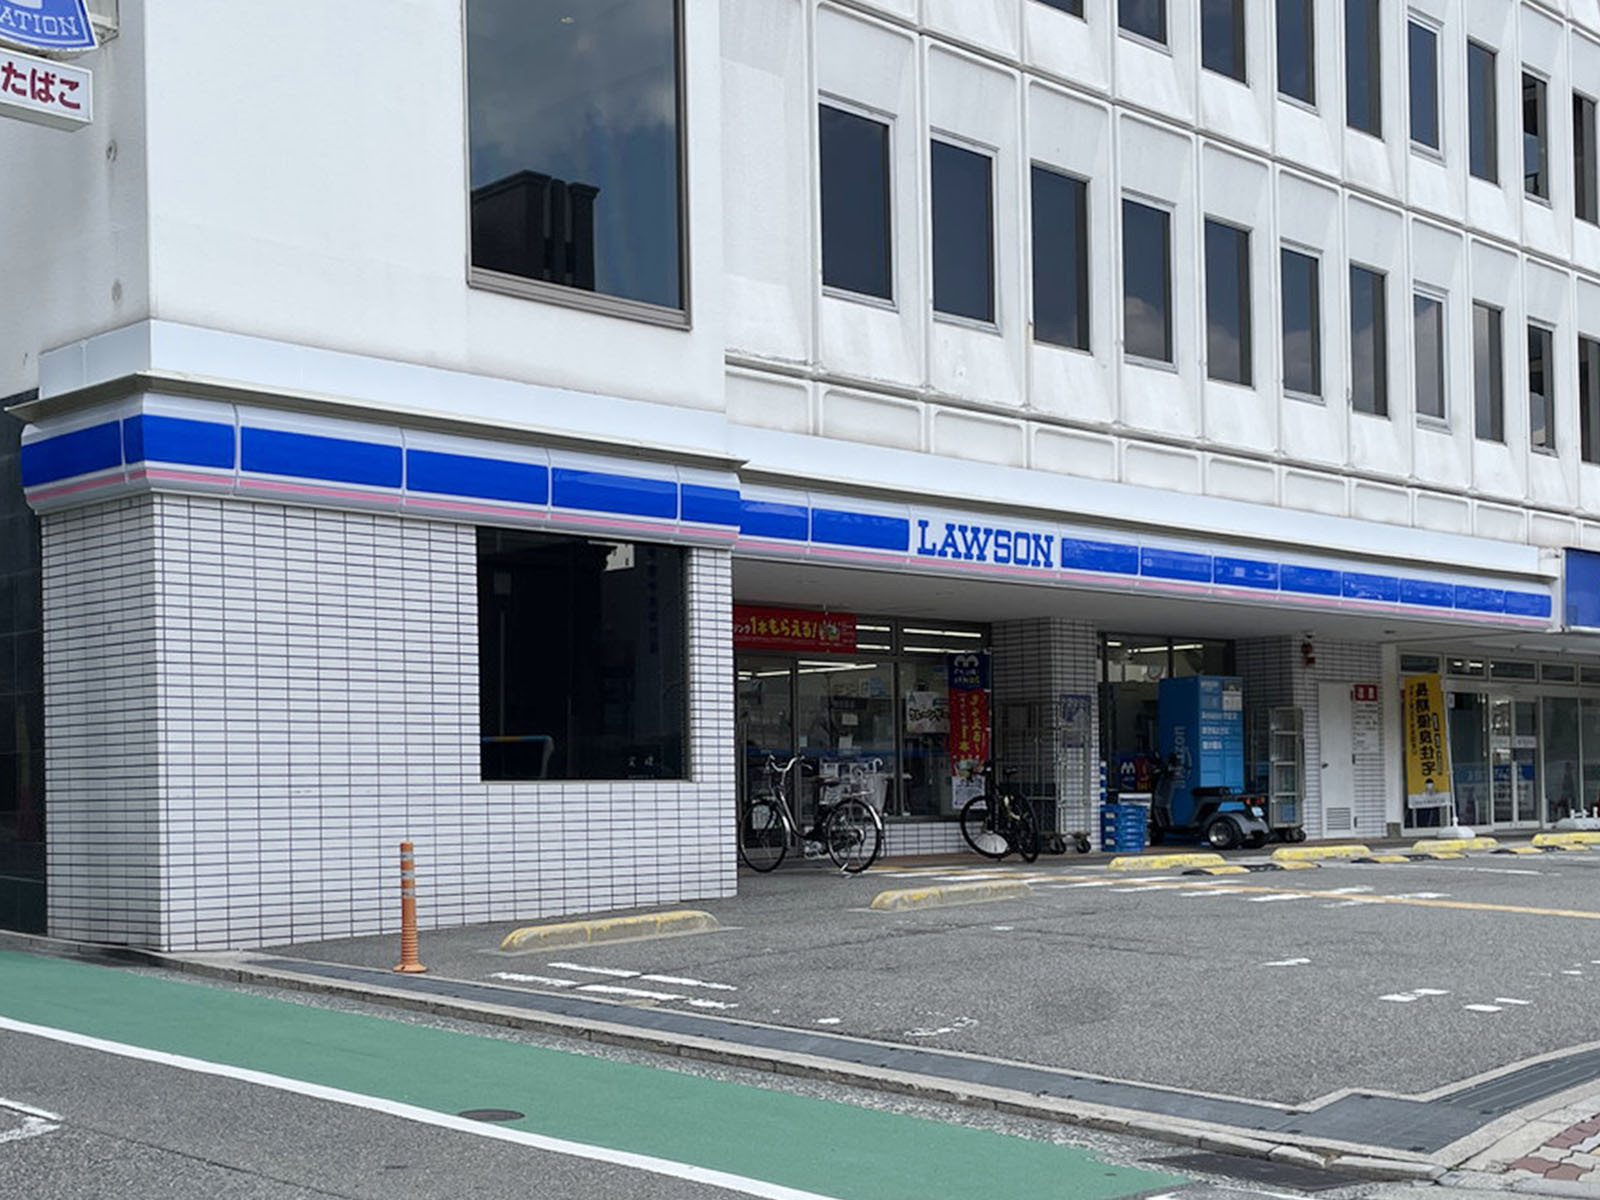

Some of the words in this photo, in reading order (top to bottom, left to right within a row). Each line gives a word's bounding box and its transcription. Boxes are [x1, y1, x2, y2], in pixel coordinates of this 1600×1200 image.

[0, 5, 79, 36] ATION
[1, 61, 81, 110] たばこ
[917, 519, 1054, 568] LAWSON
[1173, 725, 1187, 789] aazon
